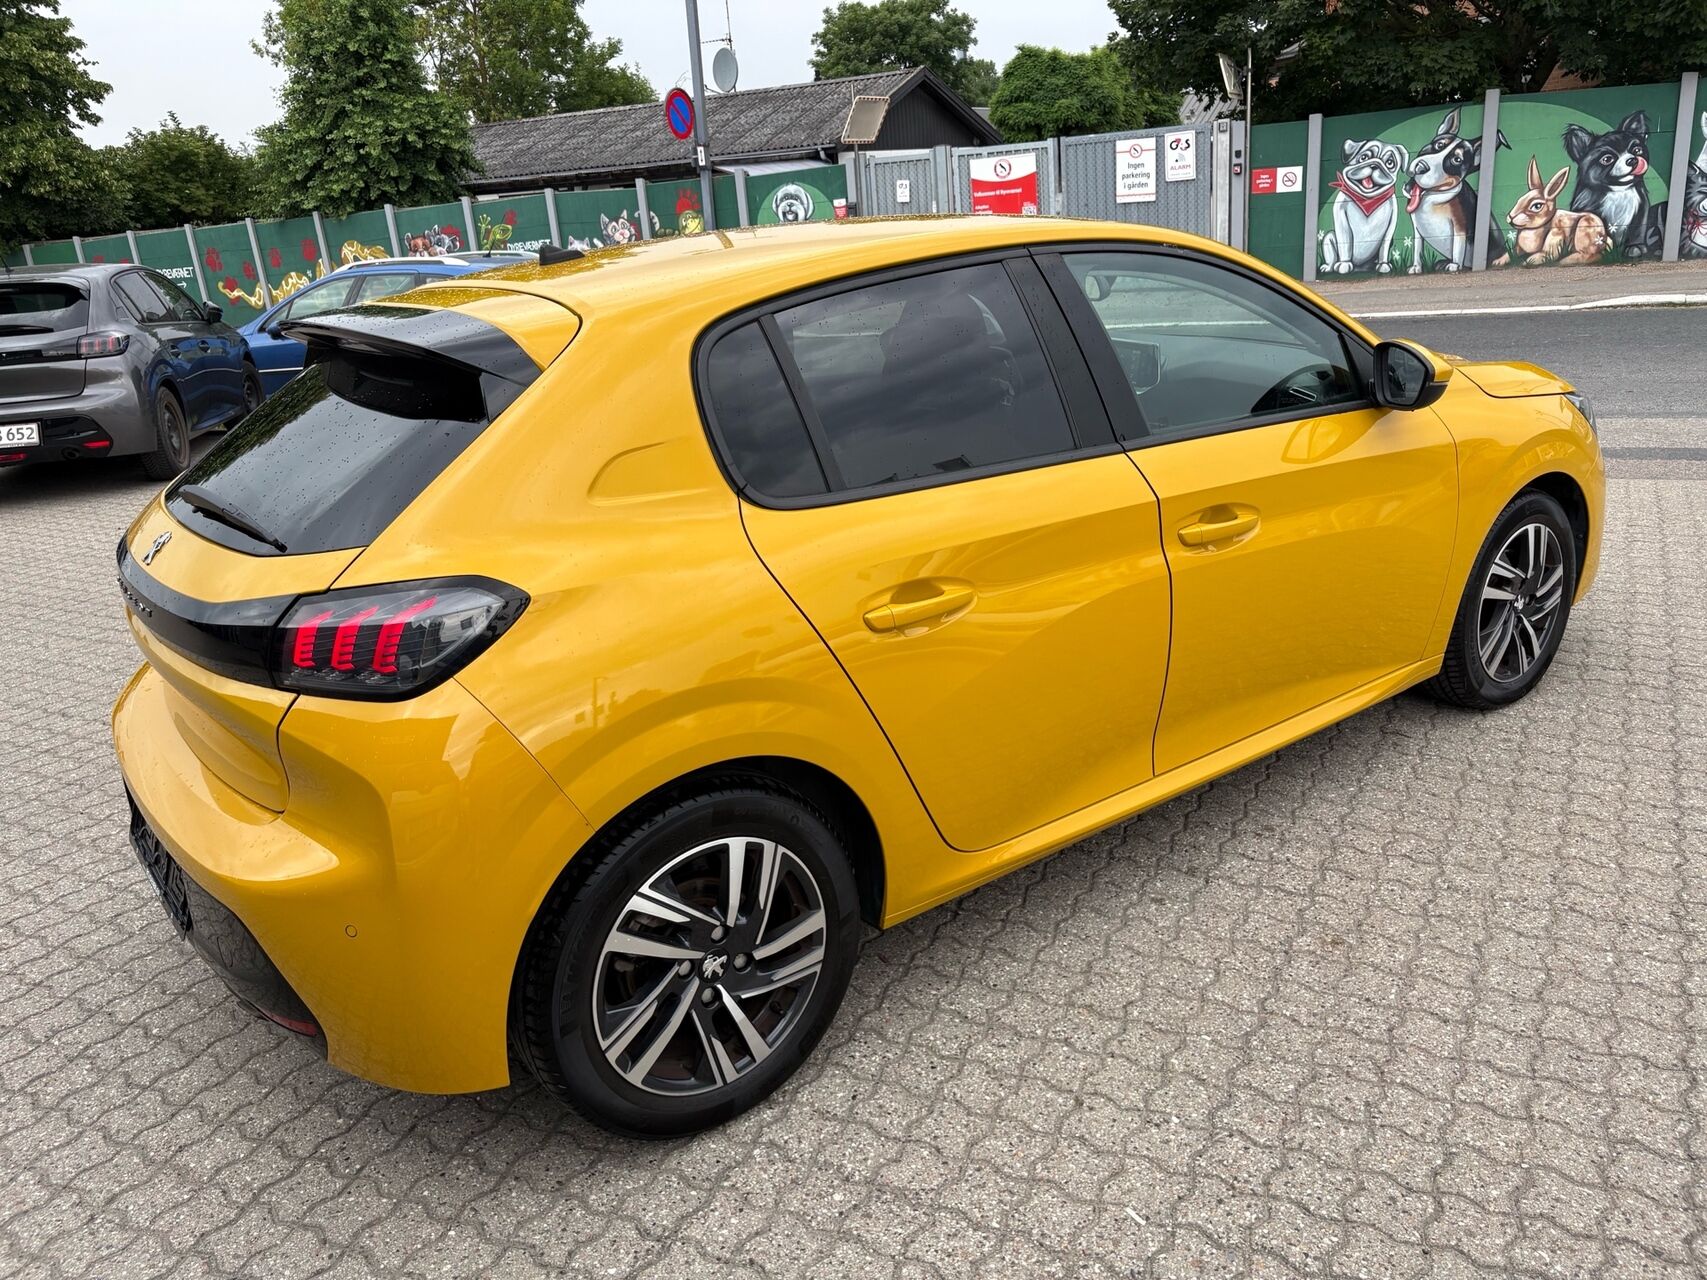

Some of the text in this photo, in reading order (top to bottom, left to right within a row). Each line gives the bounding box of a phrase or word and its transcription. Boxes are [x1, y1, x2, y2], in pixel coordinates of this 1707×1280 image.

[1127, 162, 1145, 170] Ingen
[1121, 171, 1151, 180] parkering
[1127, 182, 1149, 190] gården
[6, 426, 35, 441] 652
